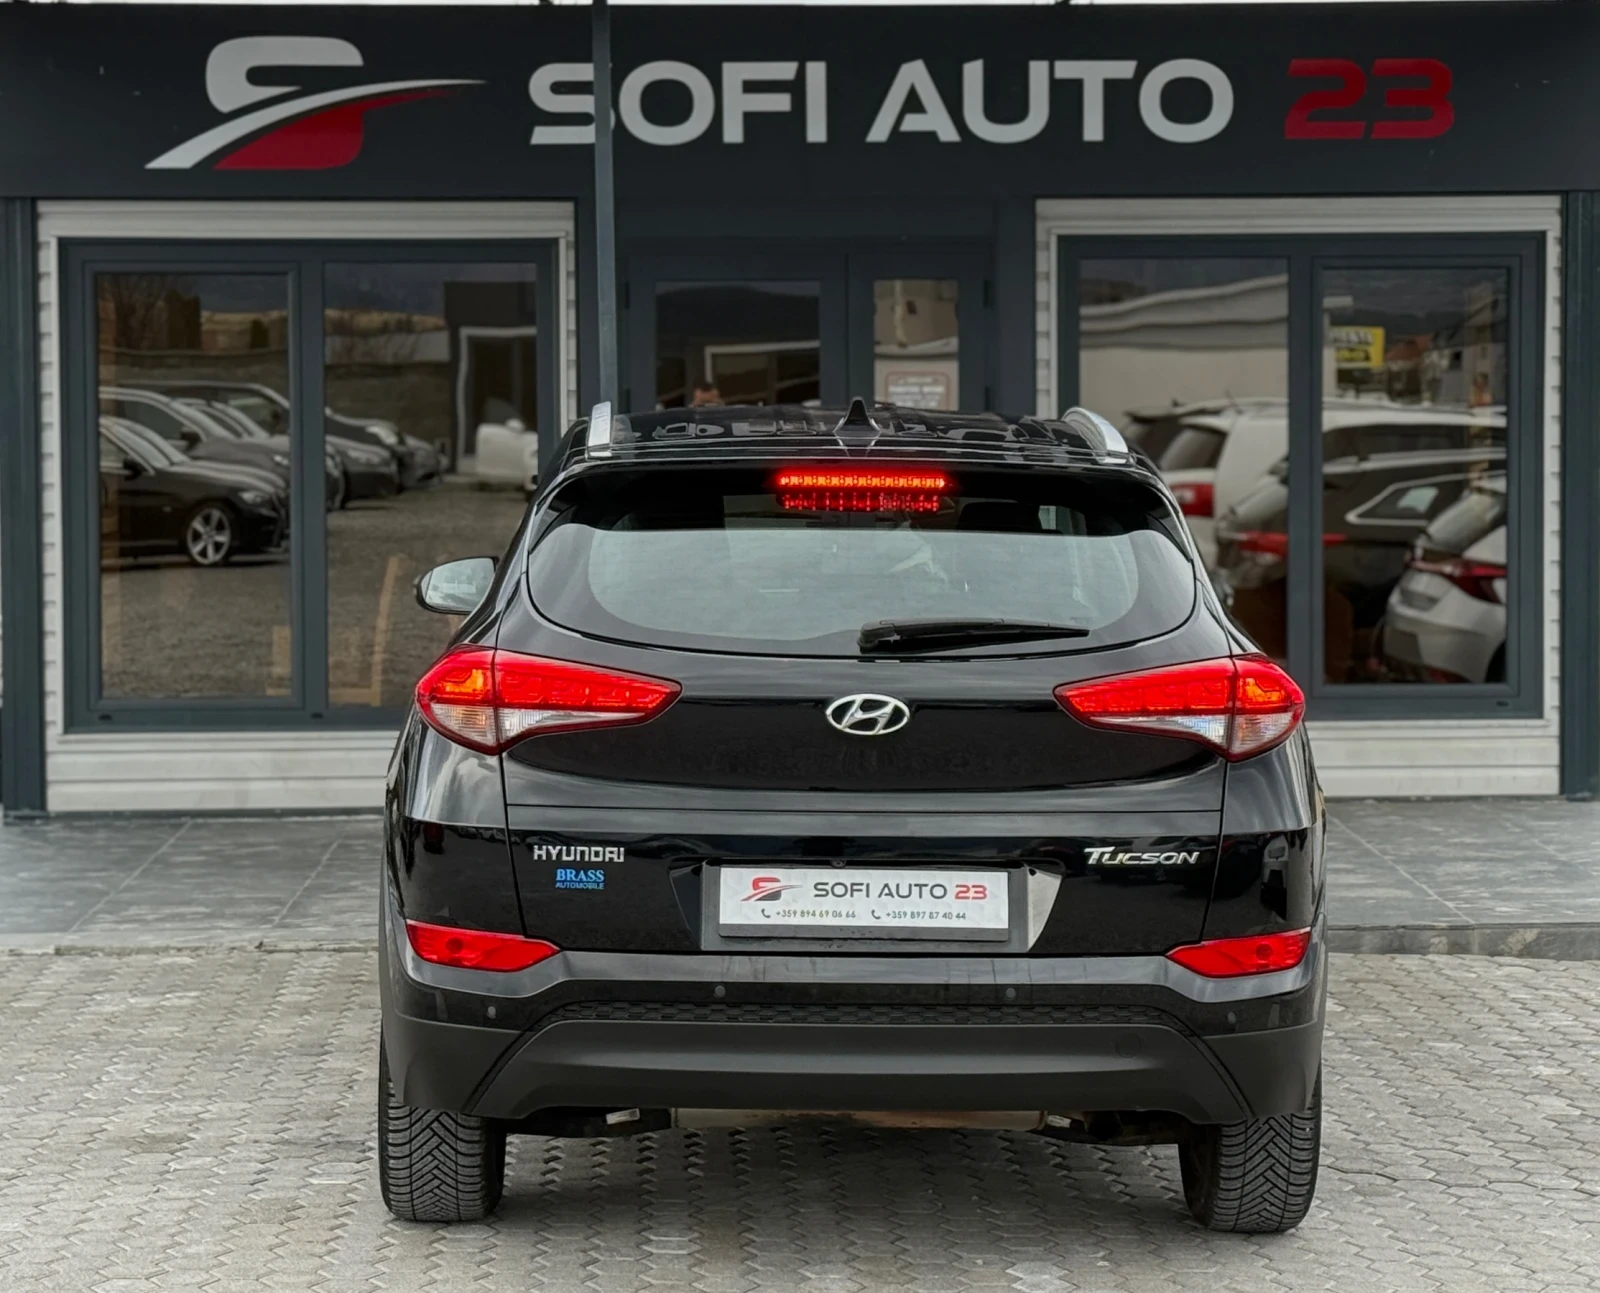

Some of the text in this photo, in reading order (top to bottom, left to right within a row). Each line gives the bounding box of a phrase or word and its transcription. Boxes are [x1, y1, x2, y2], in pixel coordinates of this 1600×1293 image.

[528, 57, 1456, 146] SOFI AUTO 23
[532, 844, 625, 863] HYUNDAI
[1083, 845, 1200, 865] TUCSON
[555, 867, 605, 882] BRASS
[555, 881, 605, 890] AUTOMOBILE
[813, 881, 988, 901] SOFI AUTO 23
[775, 909, 797, 918] +359
[885, 910, 908, 919] +359
